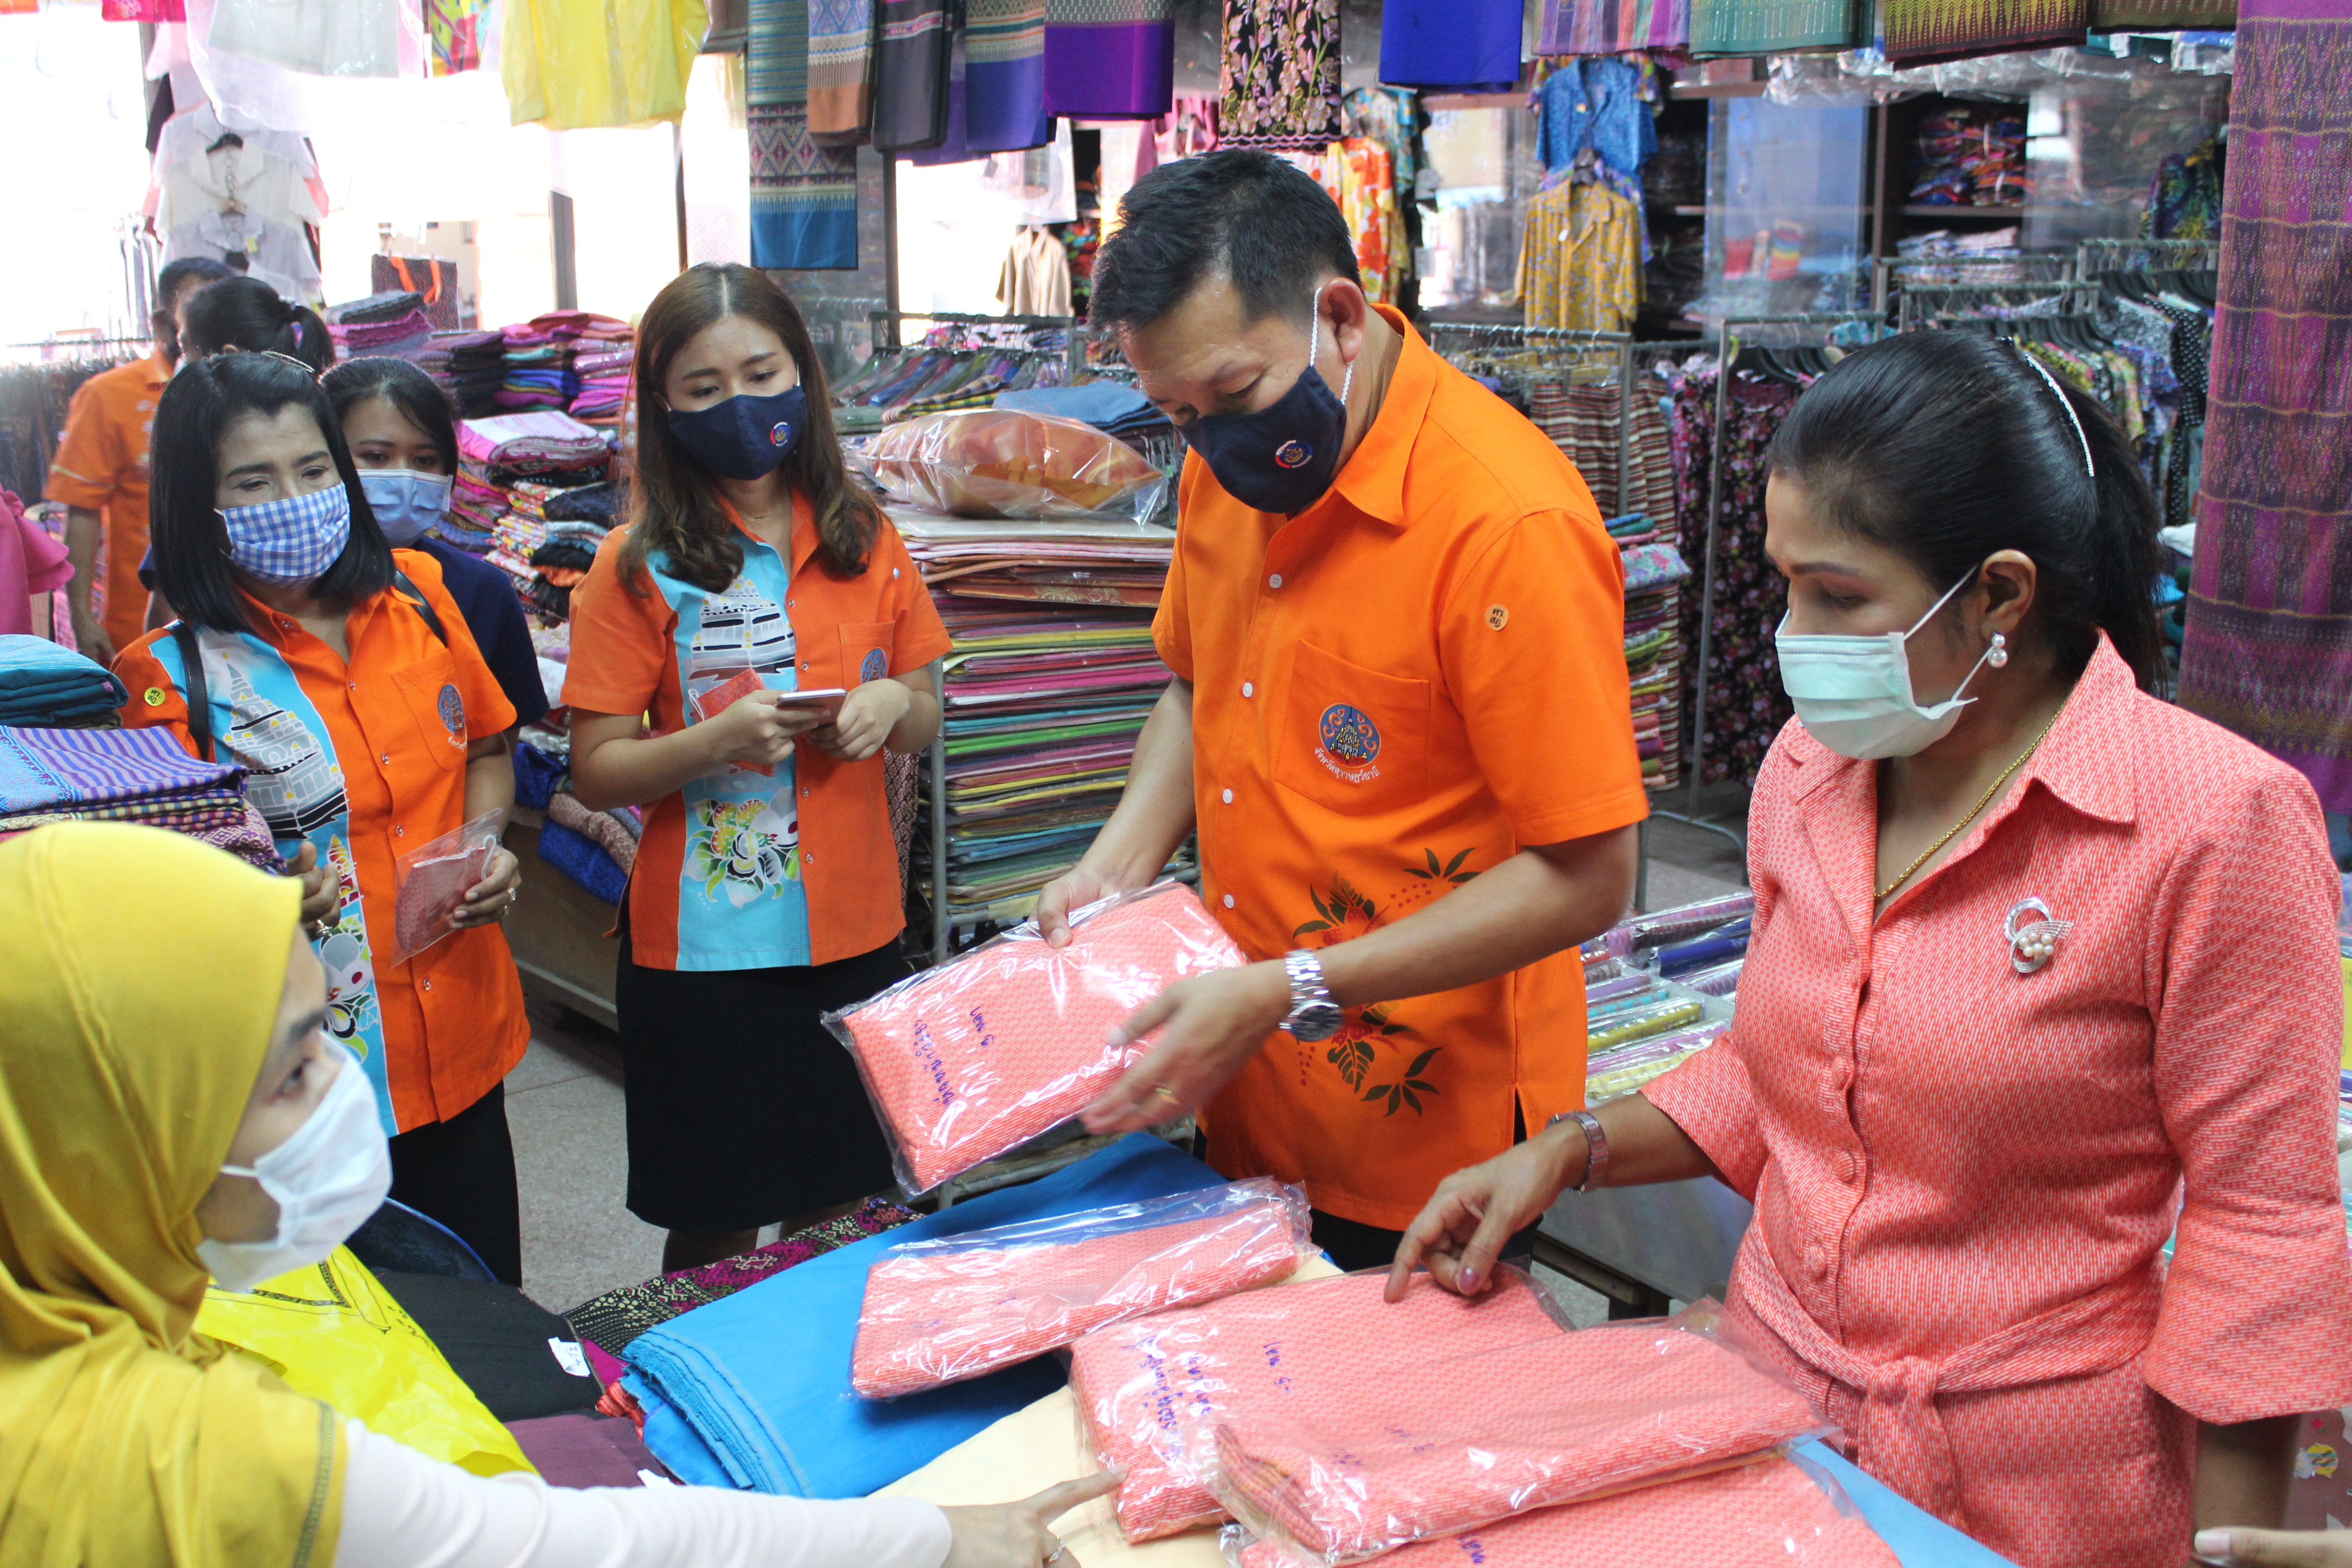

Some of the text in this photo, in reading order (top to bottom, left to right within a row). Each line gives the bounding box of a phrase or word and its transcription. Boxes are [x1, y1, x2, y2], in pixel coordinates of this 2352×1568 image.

[1315, 748, 1380, 783] จังหวัดสุราษฎร์ธานี
